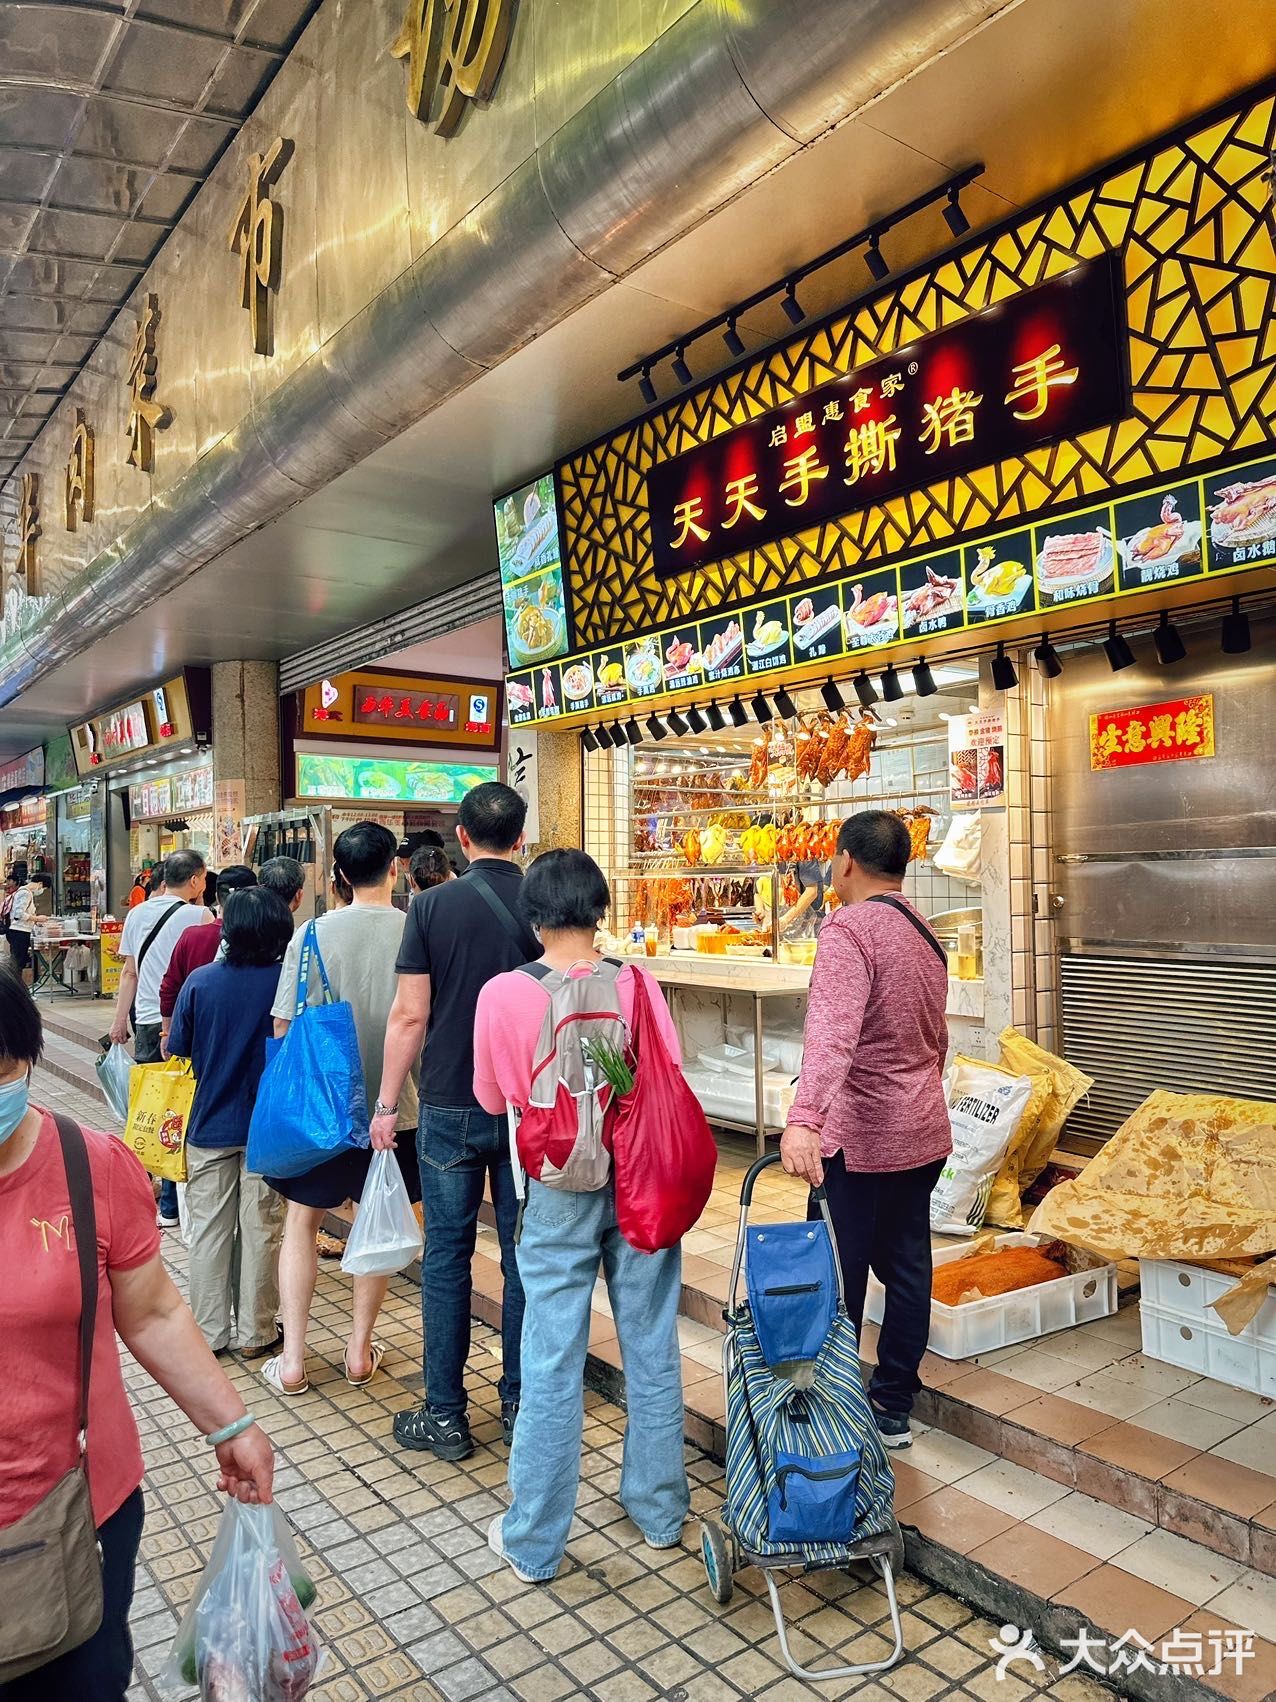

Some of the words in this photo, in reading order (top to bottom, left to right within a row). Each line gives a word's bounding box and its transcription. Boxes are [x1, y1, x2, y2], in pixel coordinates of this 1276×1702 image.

[669, 343, 1079, 549] 天天手撕猪手
[768, 372, 905, 448] 启盟惠食家
[1098, 709, 1203, 757] 生意興隆
